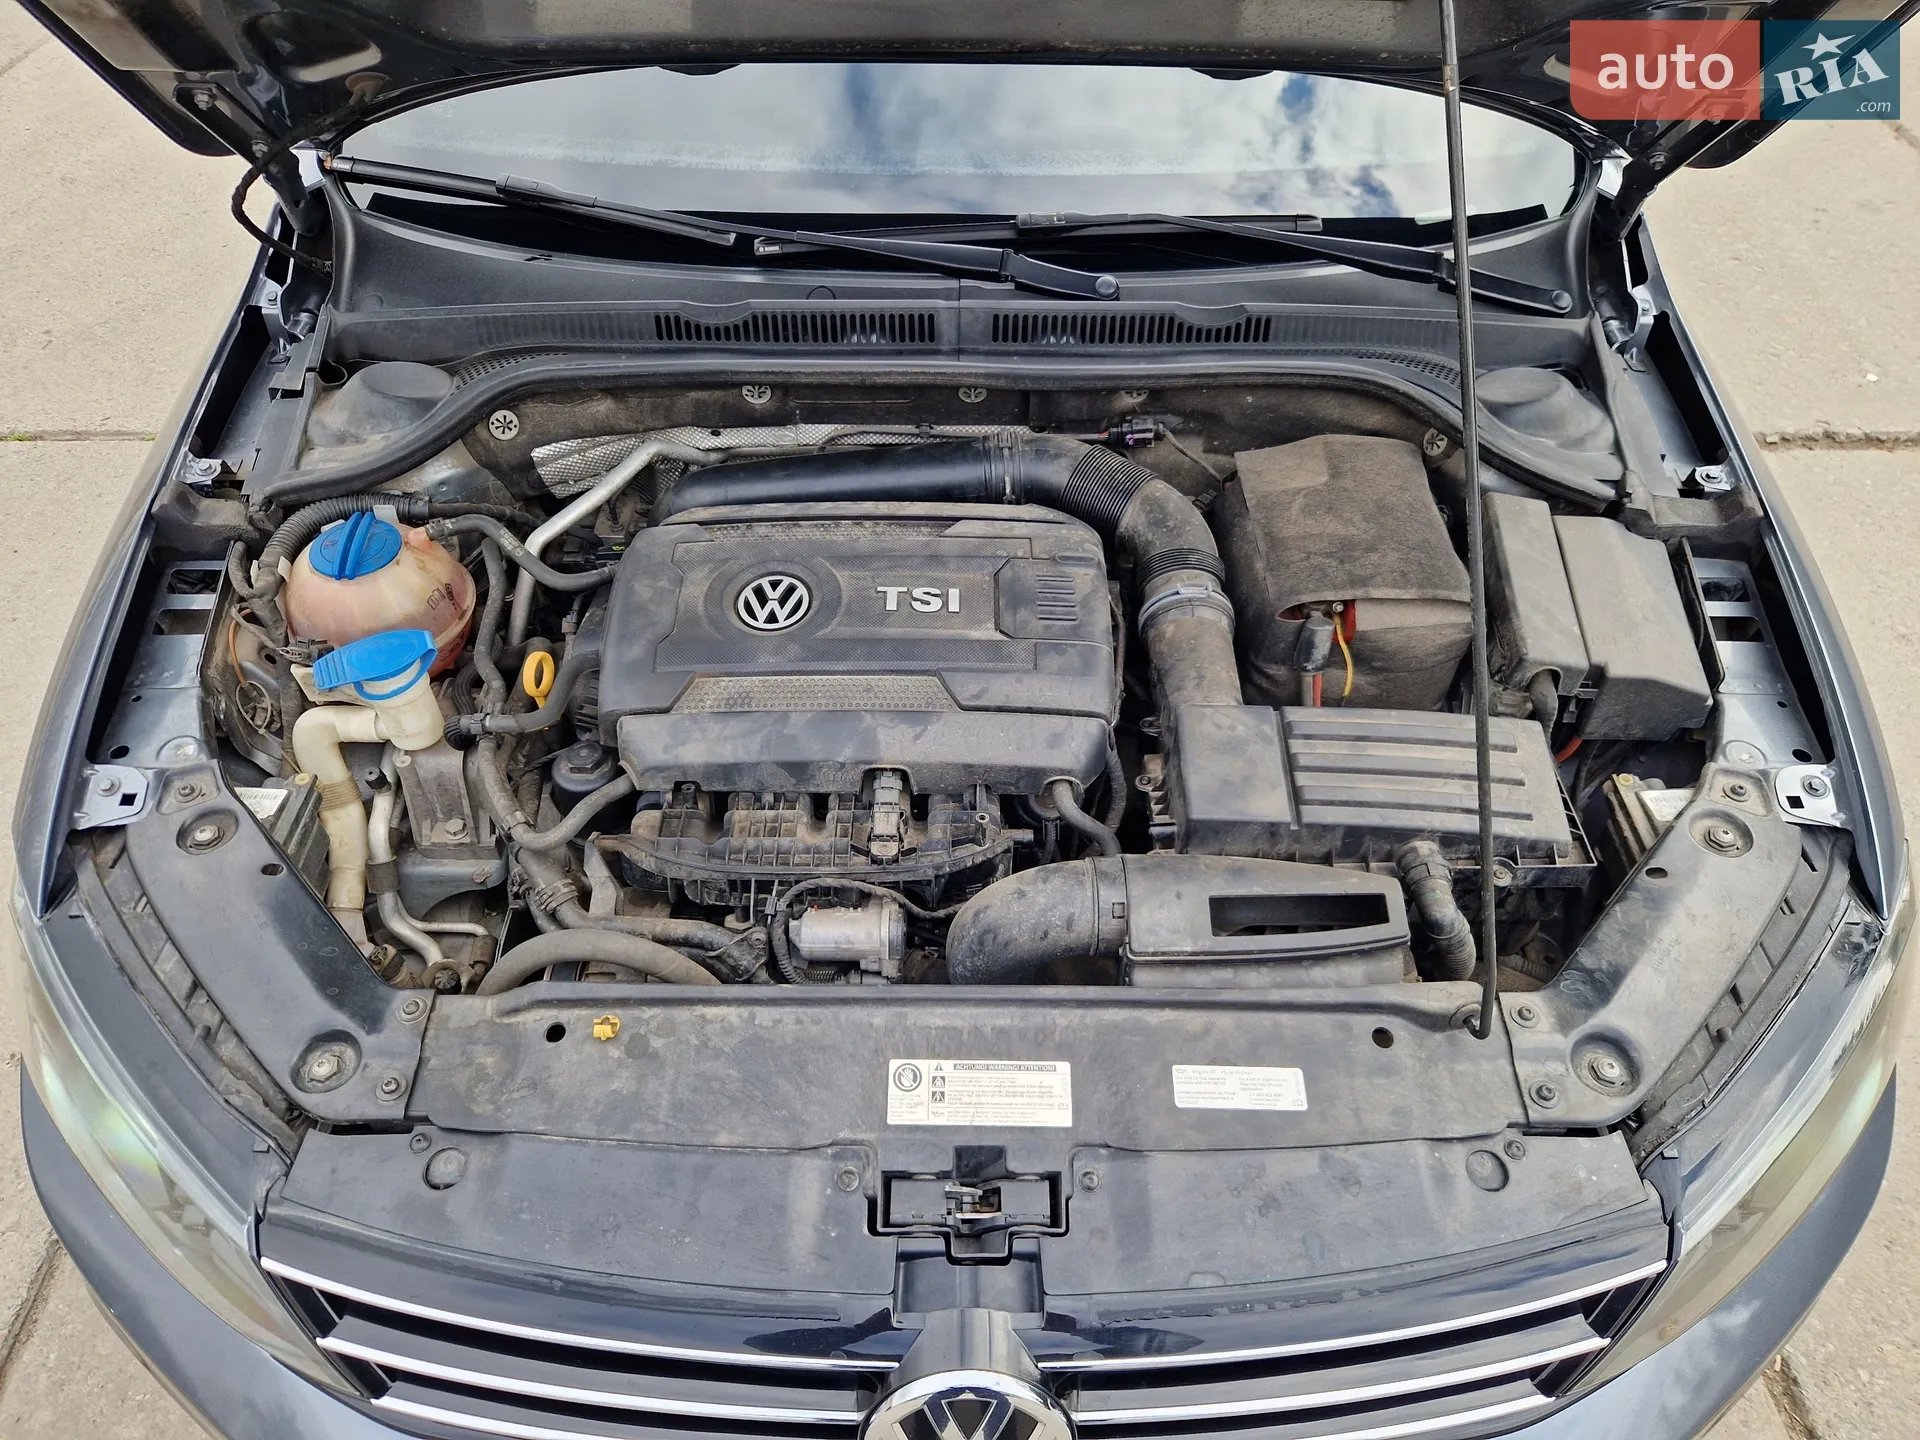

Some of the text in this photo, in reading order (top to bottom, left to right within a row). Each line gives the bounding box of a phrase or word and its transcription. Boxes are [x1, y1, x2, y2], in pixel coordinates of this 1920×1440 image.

[737, 575, 810, 630] VW
[876, 586, 960, 613] TSI
[955, 1063, 988, 1071] ACHTUNG!
[1020, 1064, 1056, 1072] ATTENTION!
